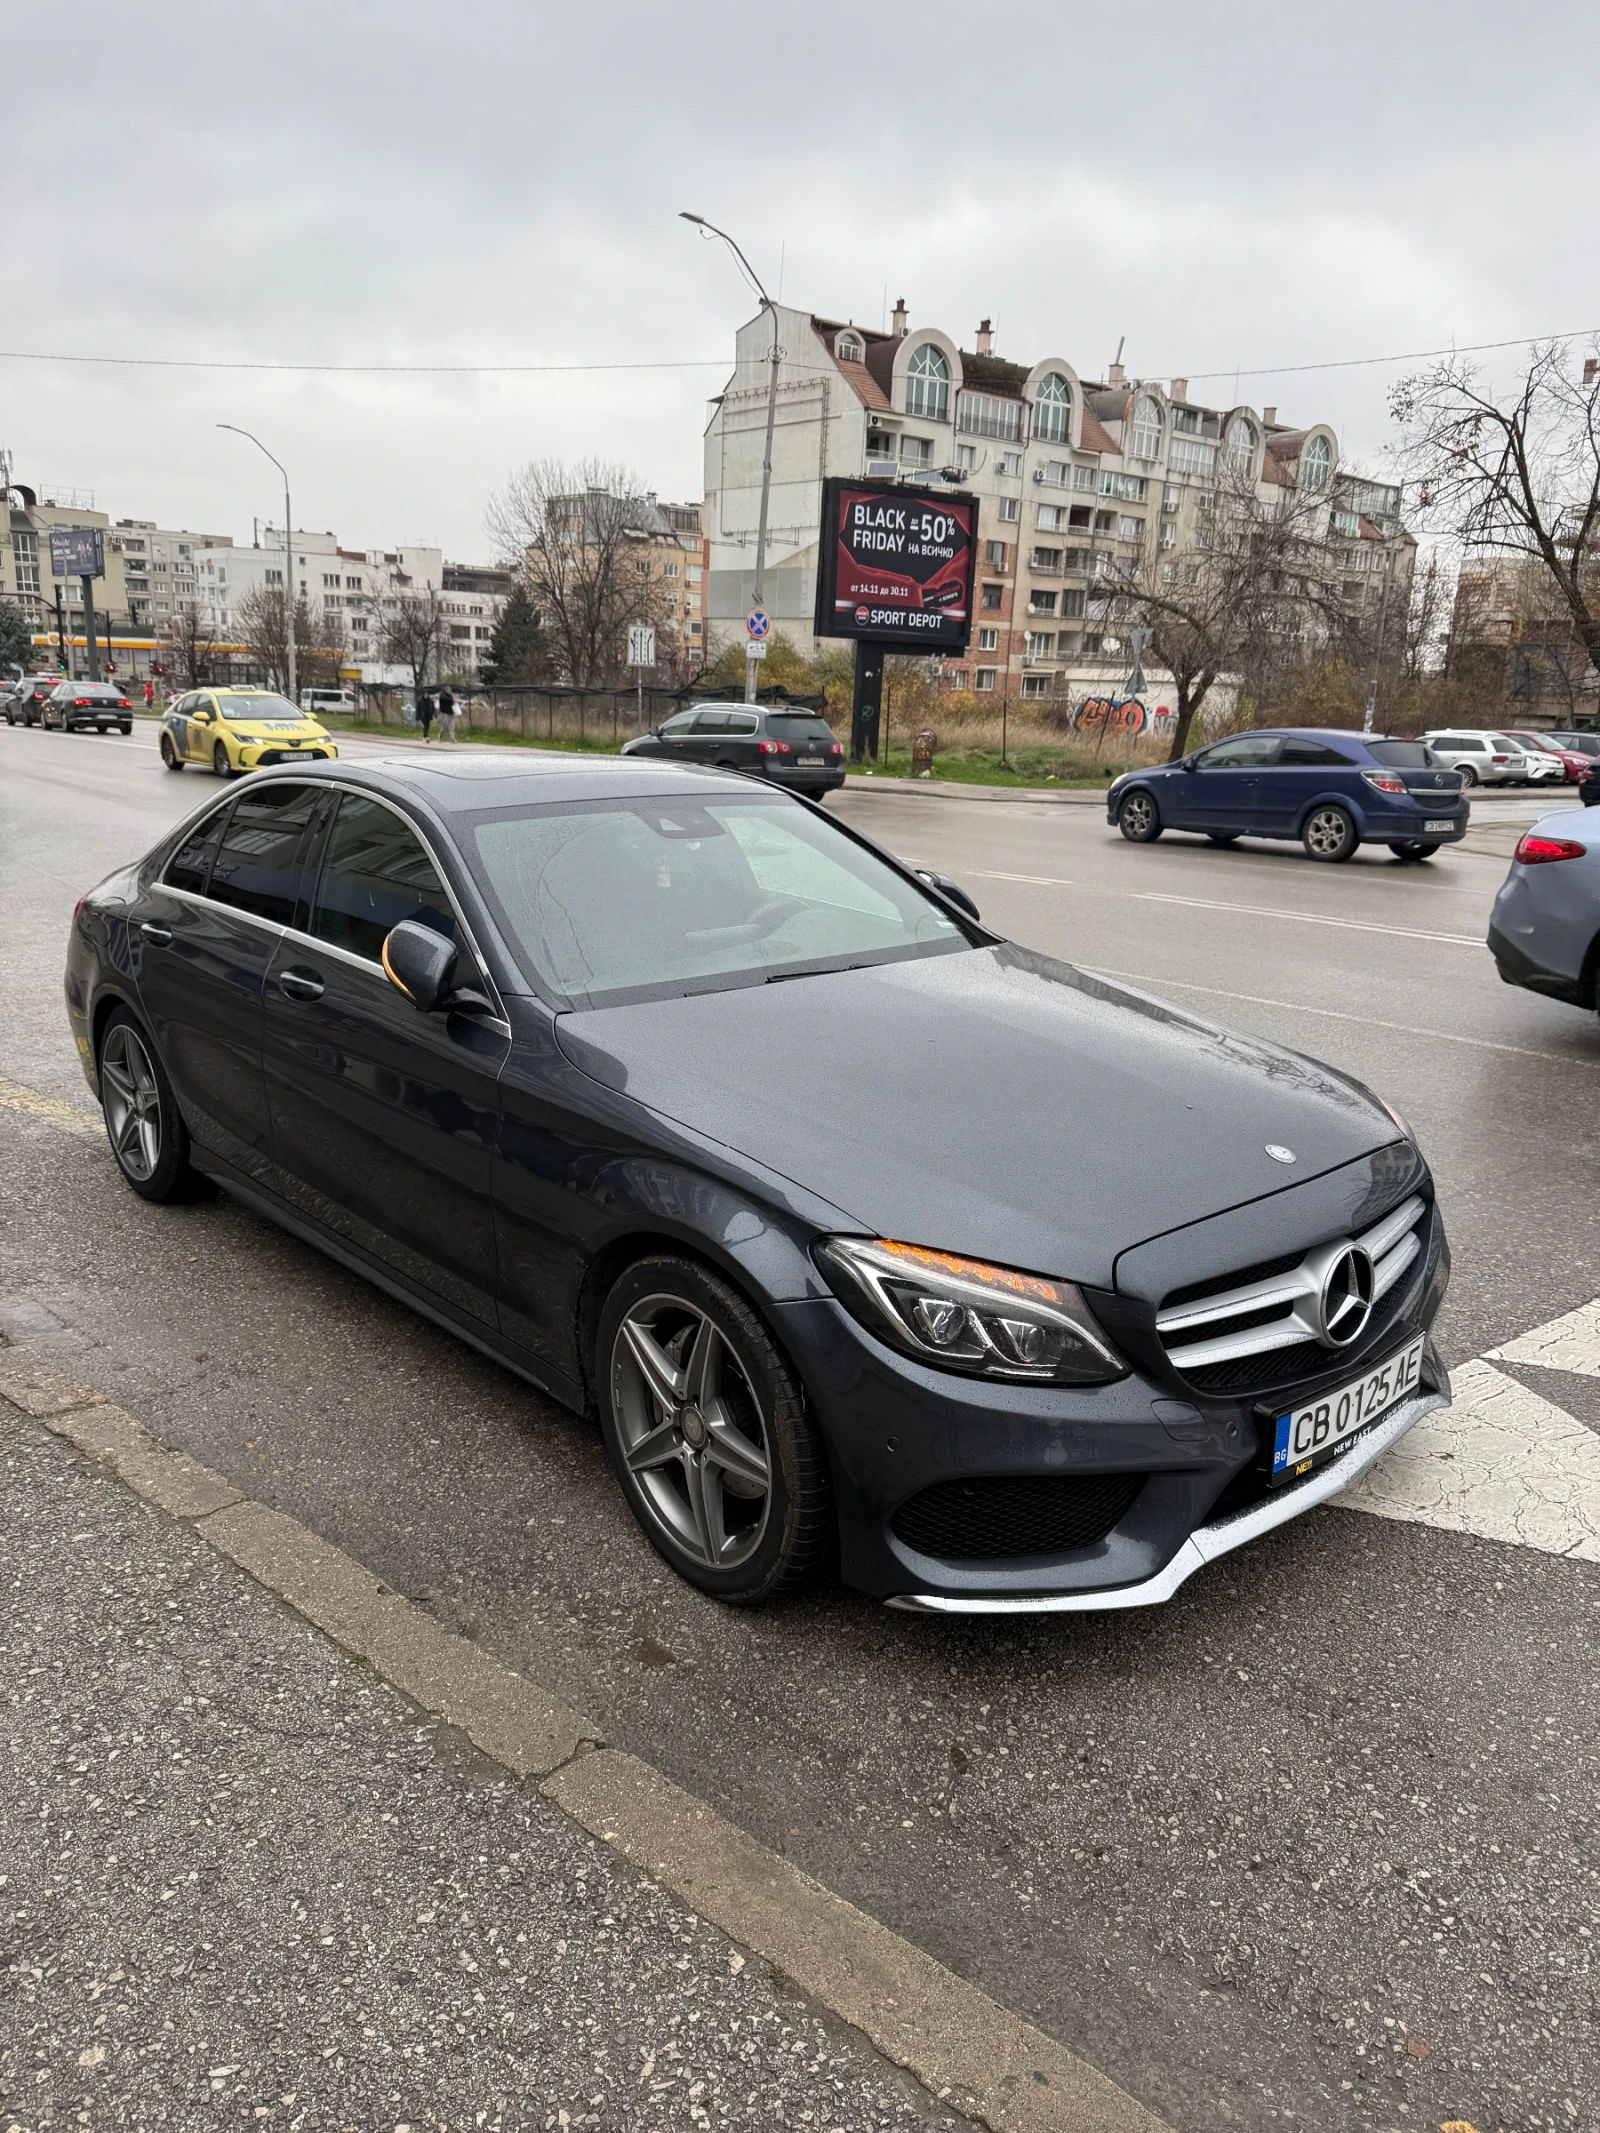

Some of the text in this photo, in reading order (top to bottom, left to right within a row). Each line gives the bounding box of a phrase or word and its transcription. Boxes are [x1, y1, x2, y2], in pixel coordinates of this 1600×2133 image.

[854, 504, 906, 531] BLACK
[852, 529, 906, 553] FRIDAY
[908, 543, 954, 559] НА ВСИЧКО
[850, 583, 908, 597] от 14.11 до 30.11
[870, 609, 906, 626] SPORT
[908, 612, 943, 629] DEPOT
[1293, 1402, 1330, 1455] CB
[1336, 1364, 1392, 1433] 0125
[1392, 1344, 1421, 1397] AE
[1274, 1448, 1287, 1465] BG
[1295, 1458, 1313, 1475] NEW
